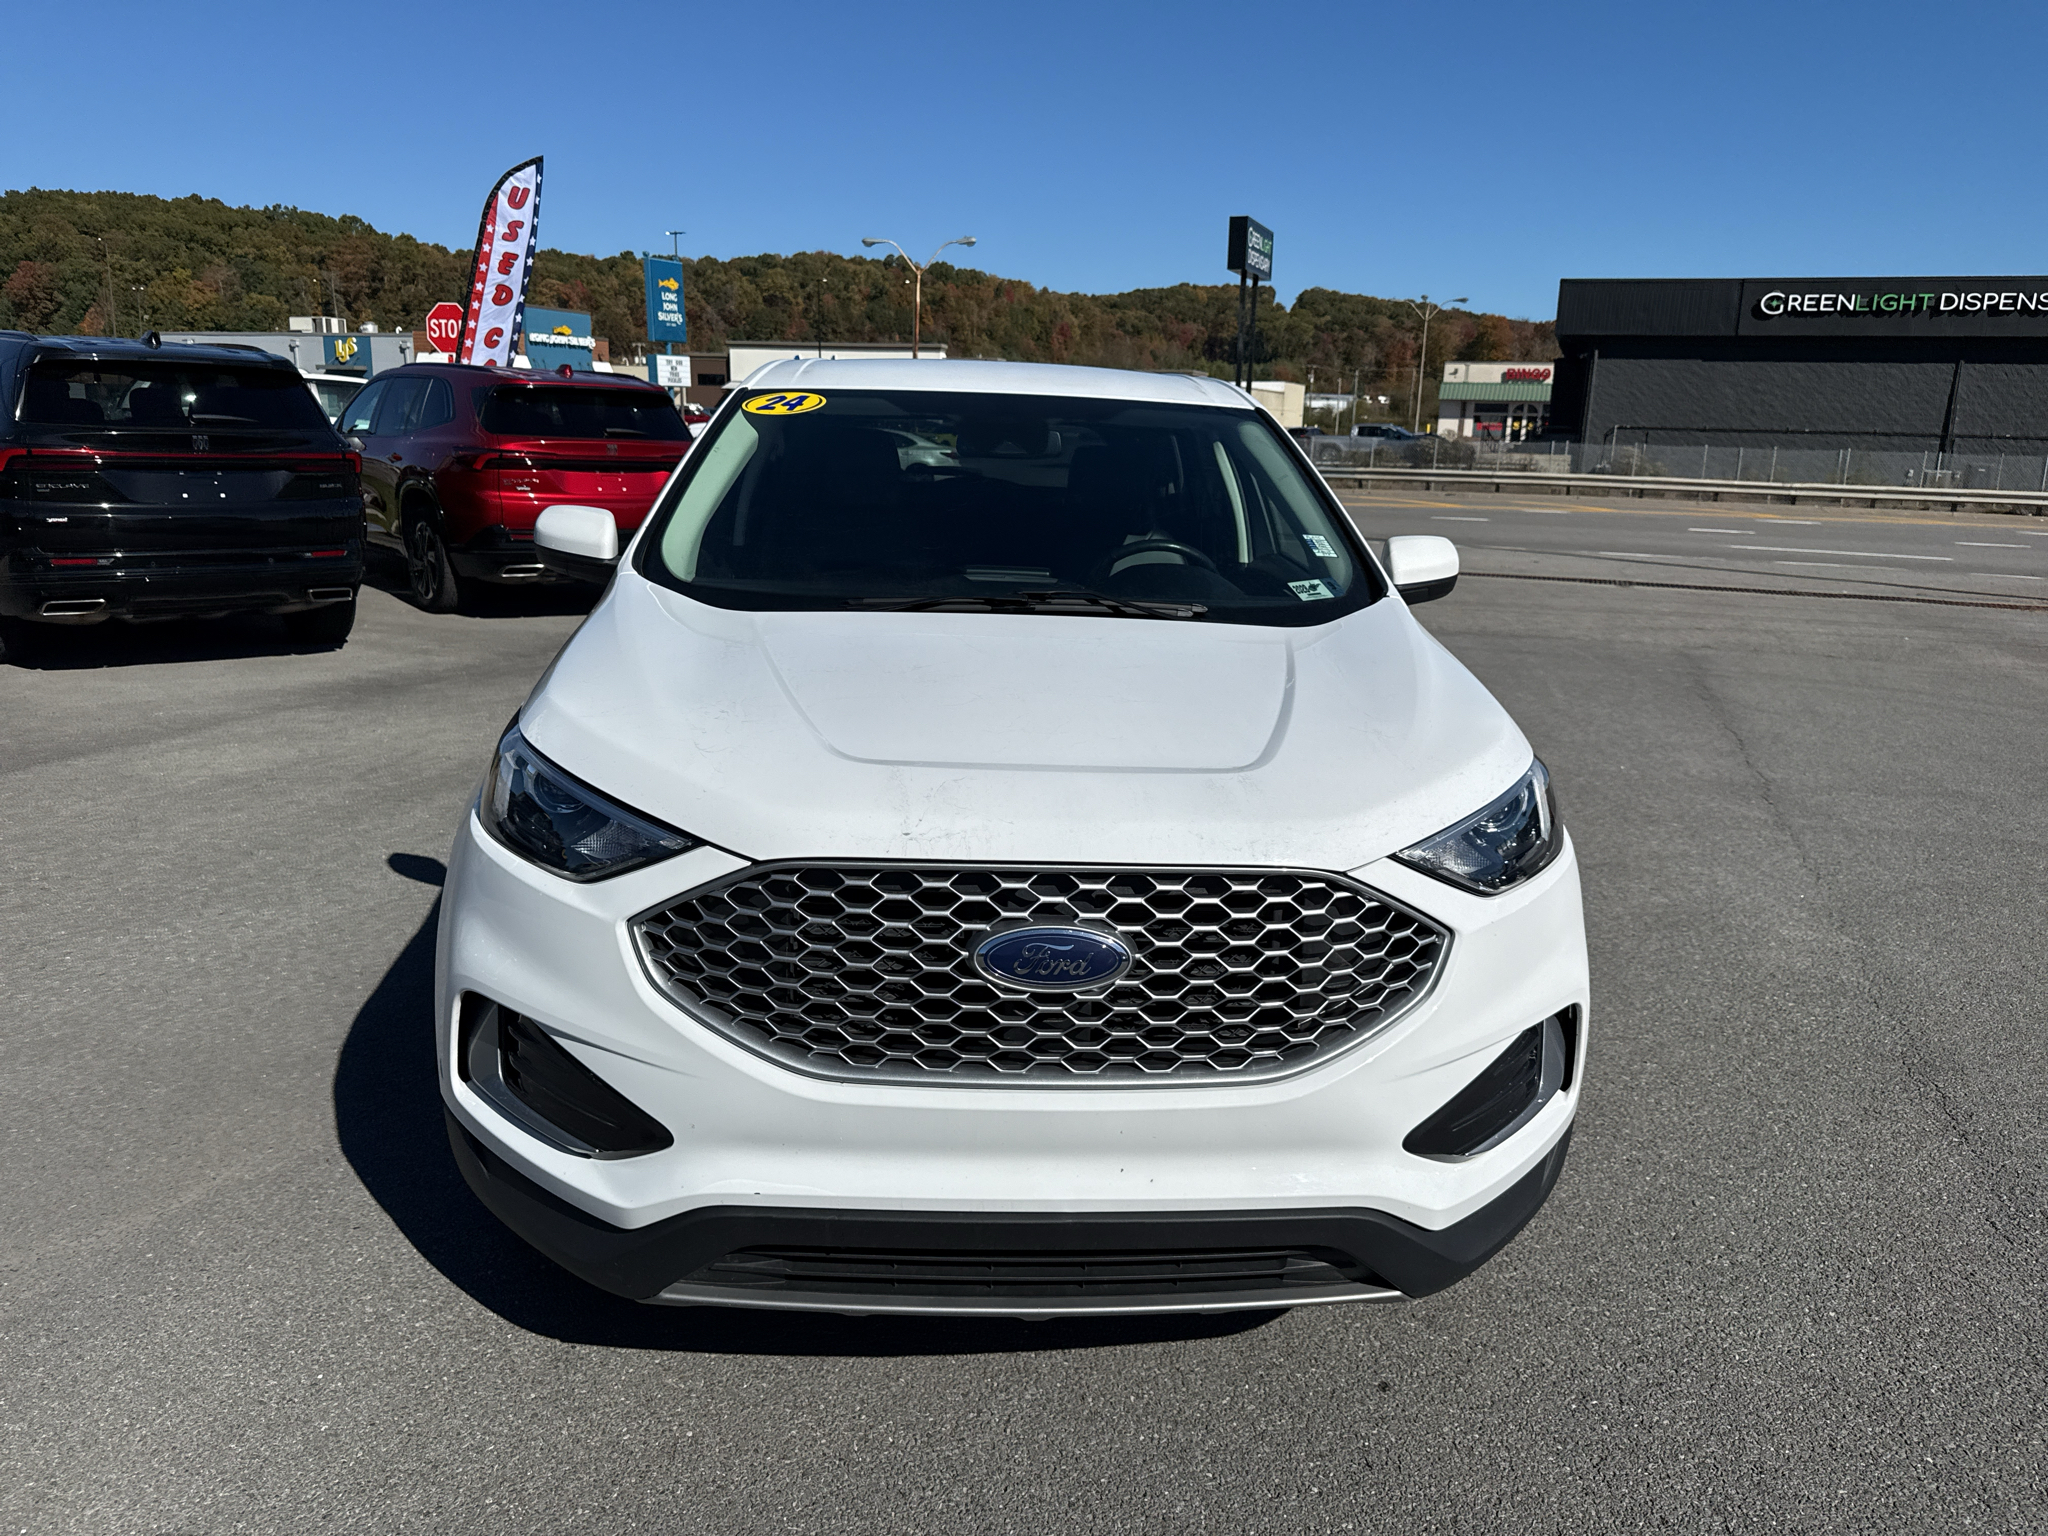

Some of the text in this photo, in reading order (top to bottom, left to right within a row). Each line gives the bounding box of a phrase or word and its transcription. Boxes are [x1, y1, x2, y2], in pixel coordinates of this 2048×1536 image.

[491, 186, 530, 306] USED
[661, 291, 678, 302] LONG
[1760, 291, 2048, 315] GREENLIGHT DISPENS
[662, 302, 678, 312] JOHN
[657, 311, 683, 325] SILVER'S
[430, 318, 462, 339] STO
[1506, 368, 1551, 380] BINGO
[756, 395, 810, 411] 24
[1013, 942, 1095, 976] Ford
